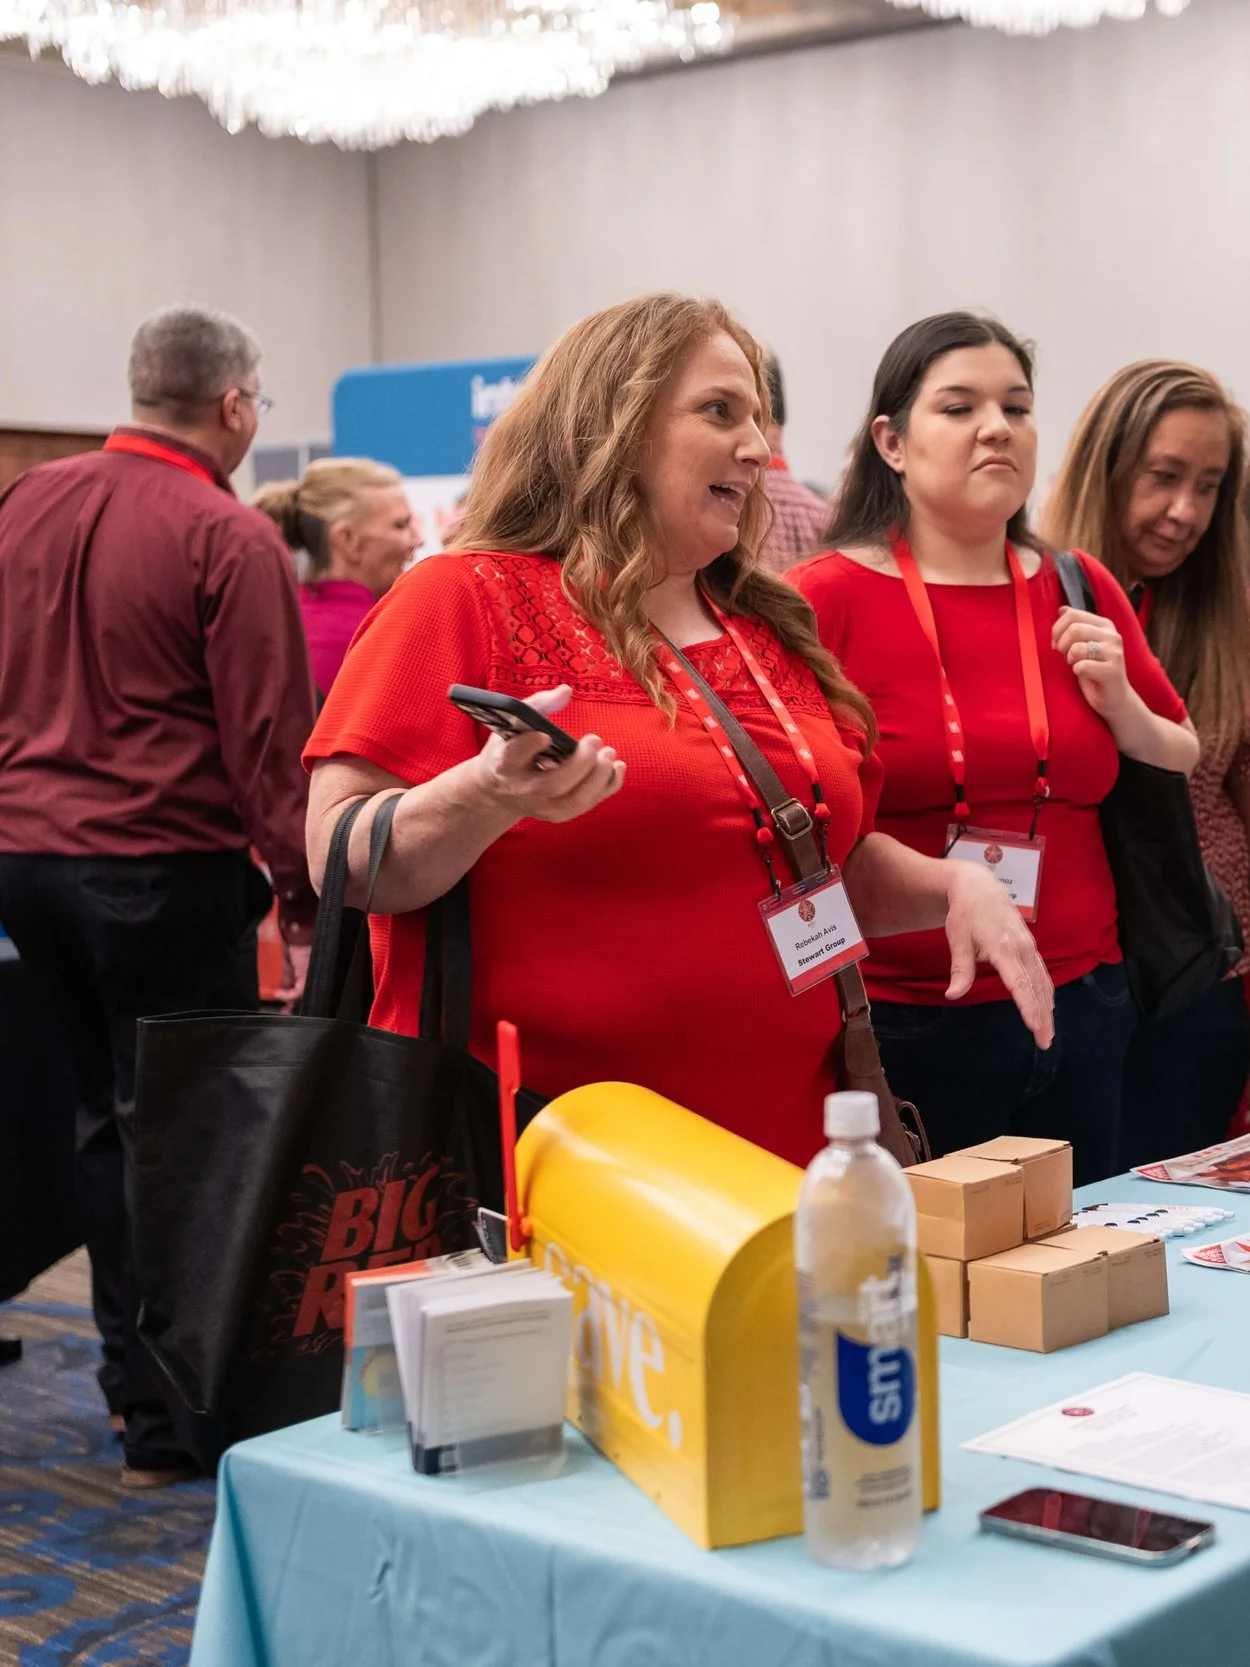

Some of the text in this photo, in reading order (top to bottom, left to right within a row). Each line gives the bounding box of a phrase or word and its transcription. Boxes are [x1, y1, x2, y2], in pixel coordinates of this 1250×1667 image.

[795, 931, 823, 949] Rebekah
[823, 924, 837, 935] Avis
[798, 936, 846, 967] Stewart Group
[320, 1164, 440, 1262] BIG
[860, 1272, 904, 1425] smart
